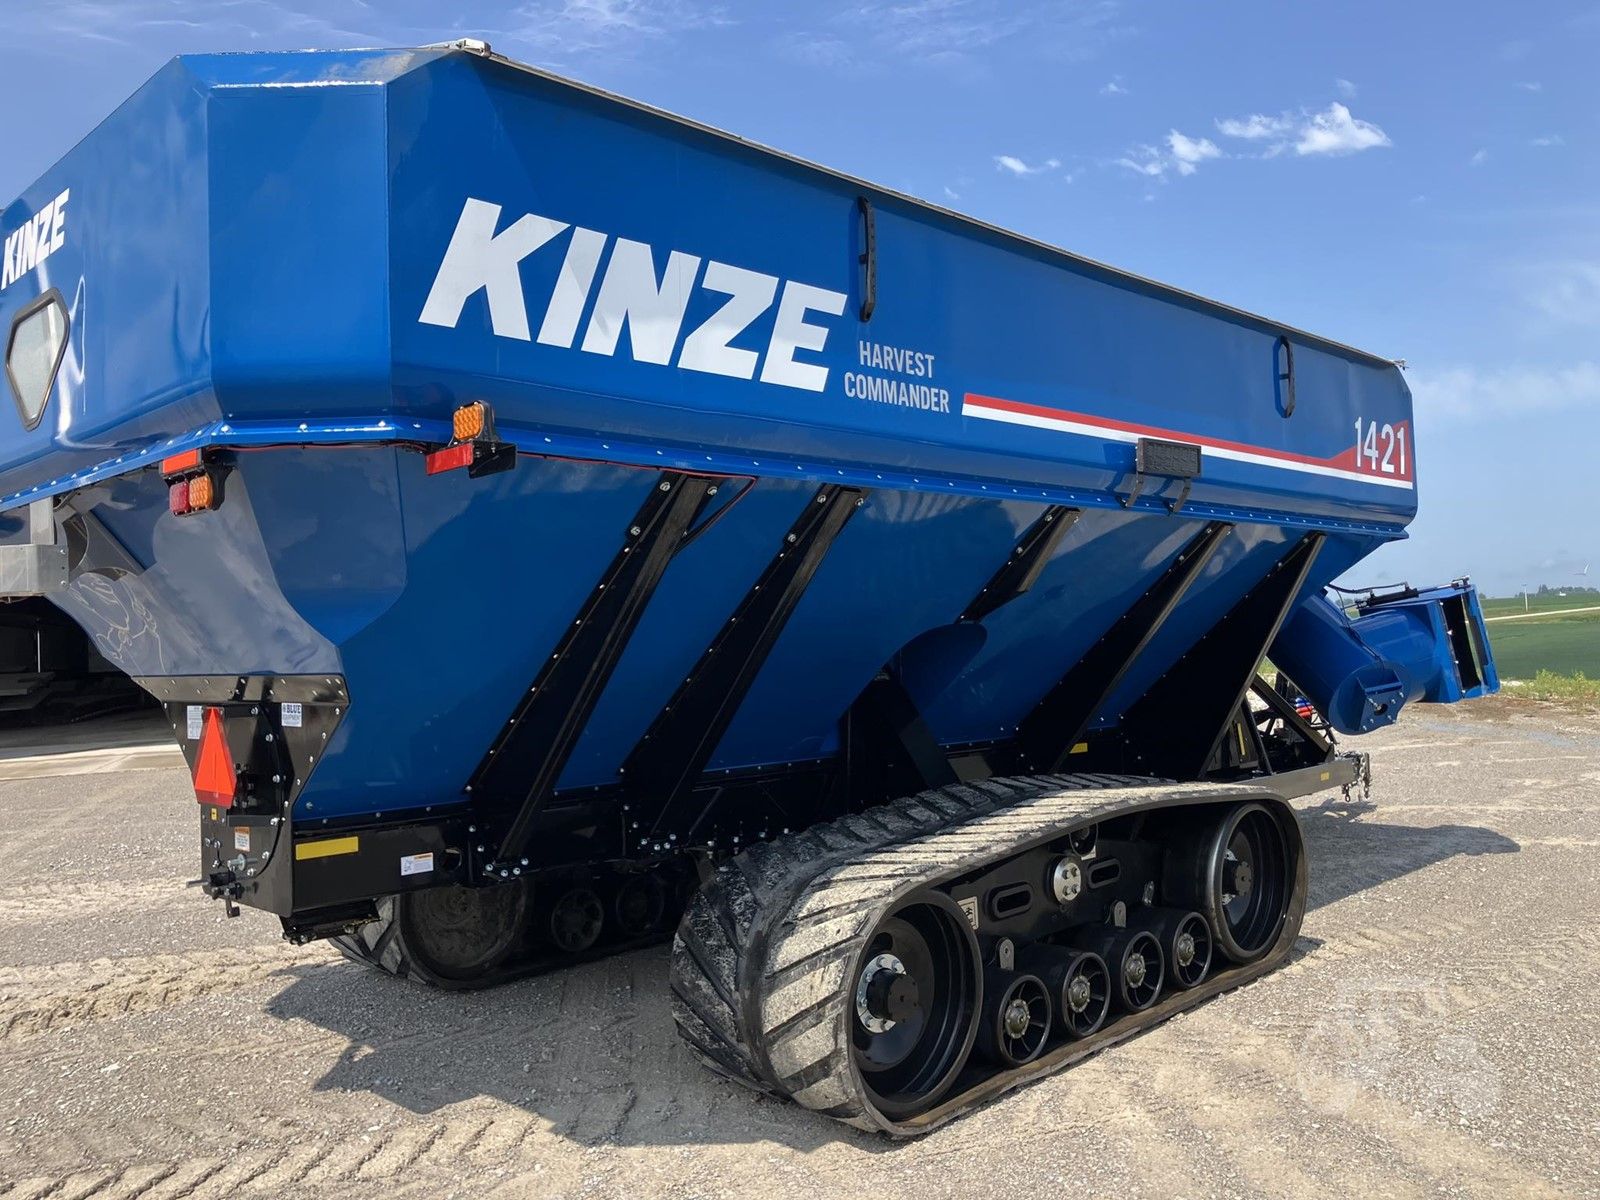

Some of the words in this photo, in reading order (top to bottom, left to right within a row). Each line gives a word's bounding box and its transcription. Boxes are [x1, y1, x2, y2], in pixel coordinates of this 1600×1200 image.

[1, 187, 70, 291] KINZE
[418, 197, 848, 393] KINZE
[859, 340, 935, 378] HARVEST
[844, 371, 950, 413] COMMANDER
[1354, 416, 1405, 475] 1421
